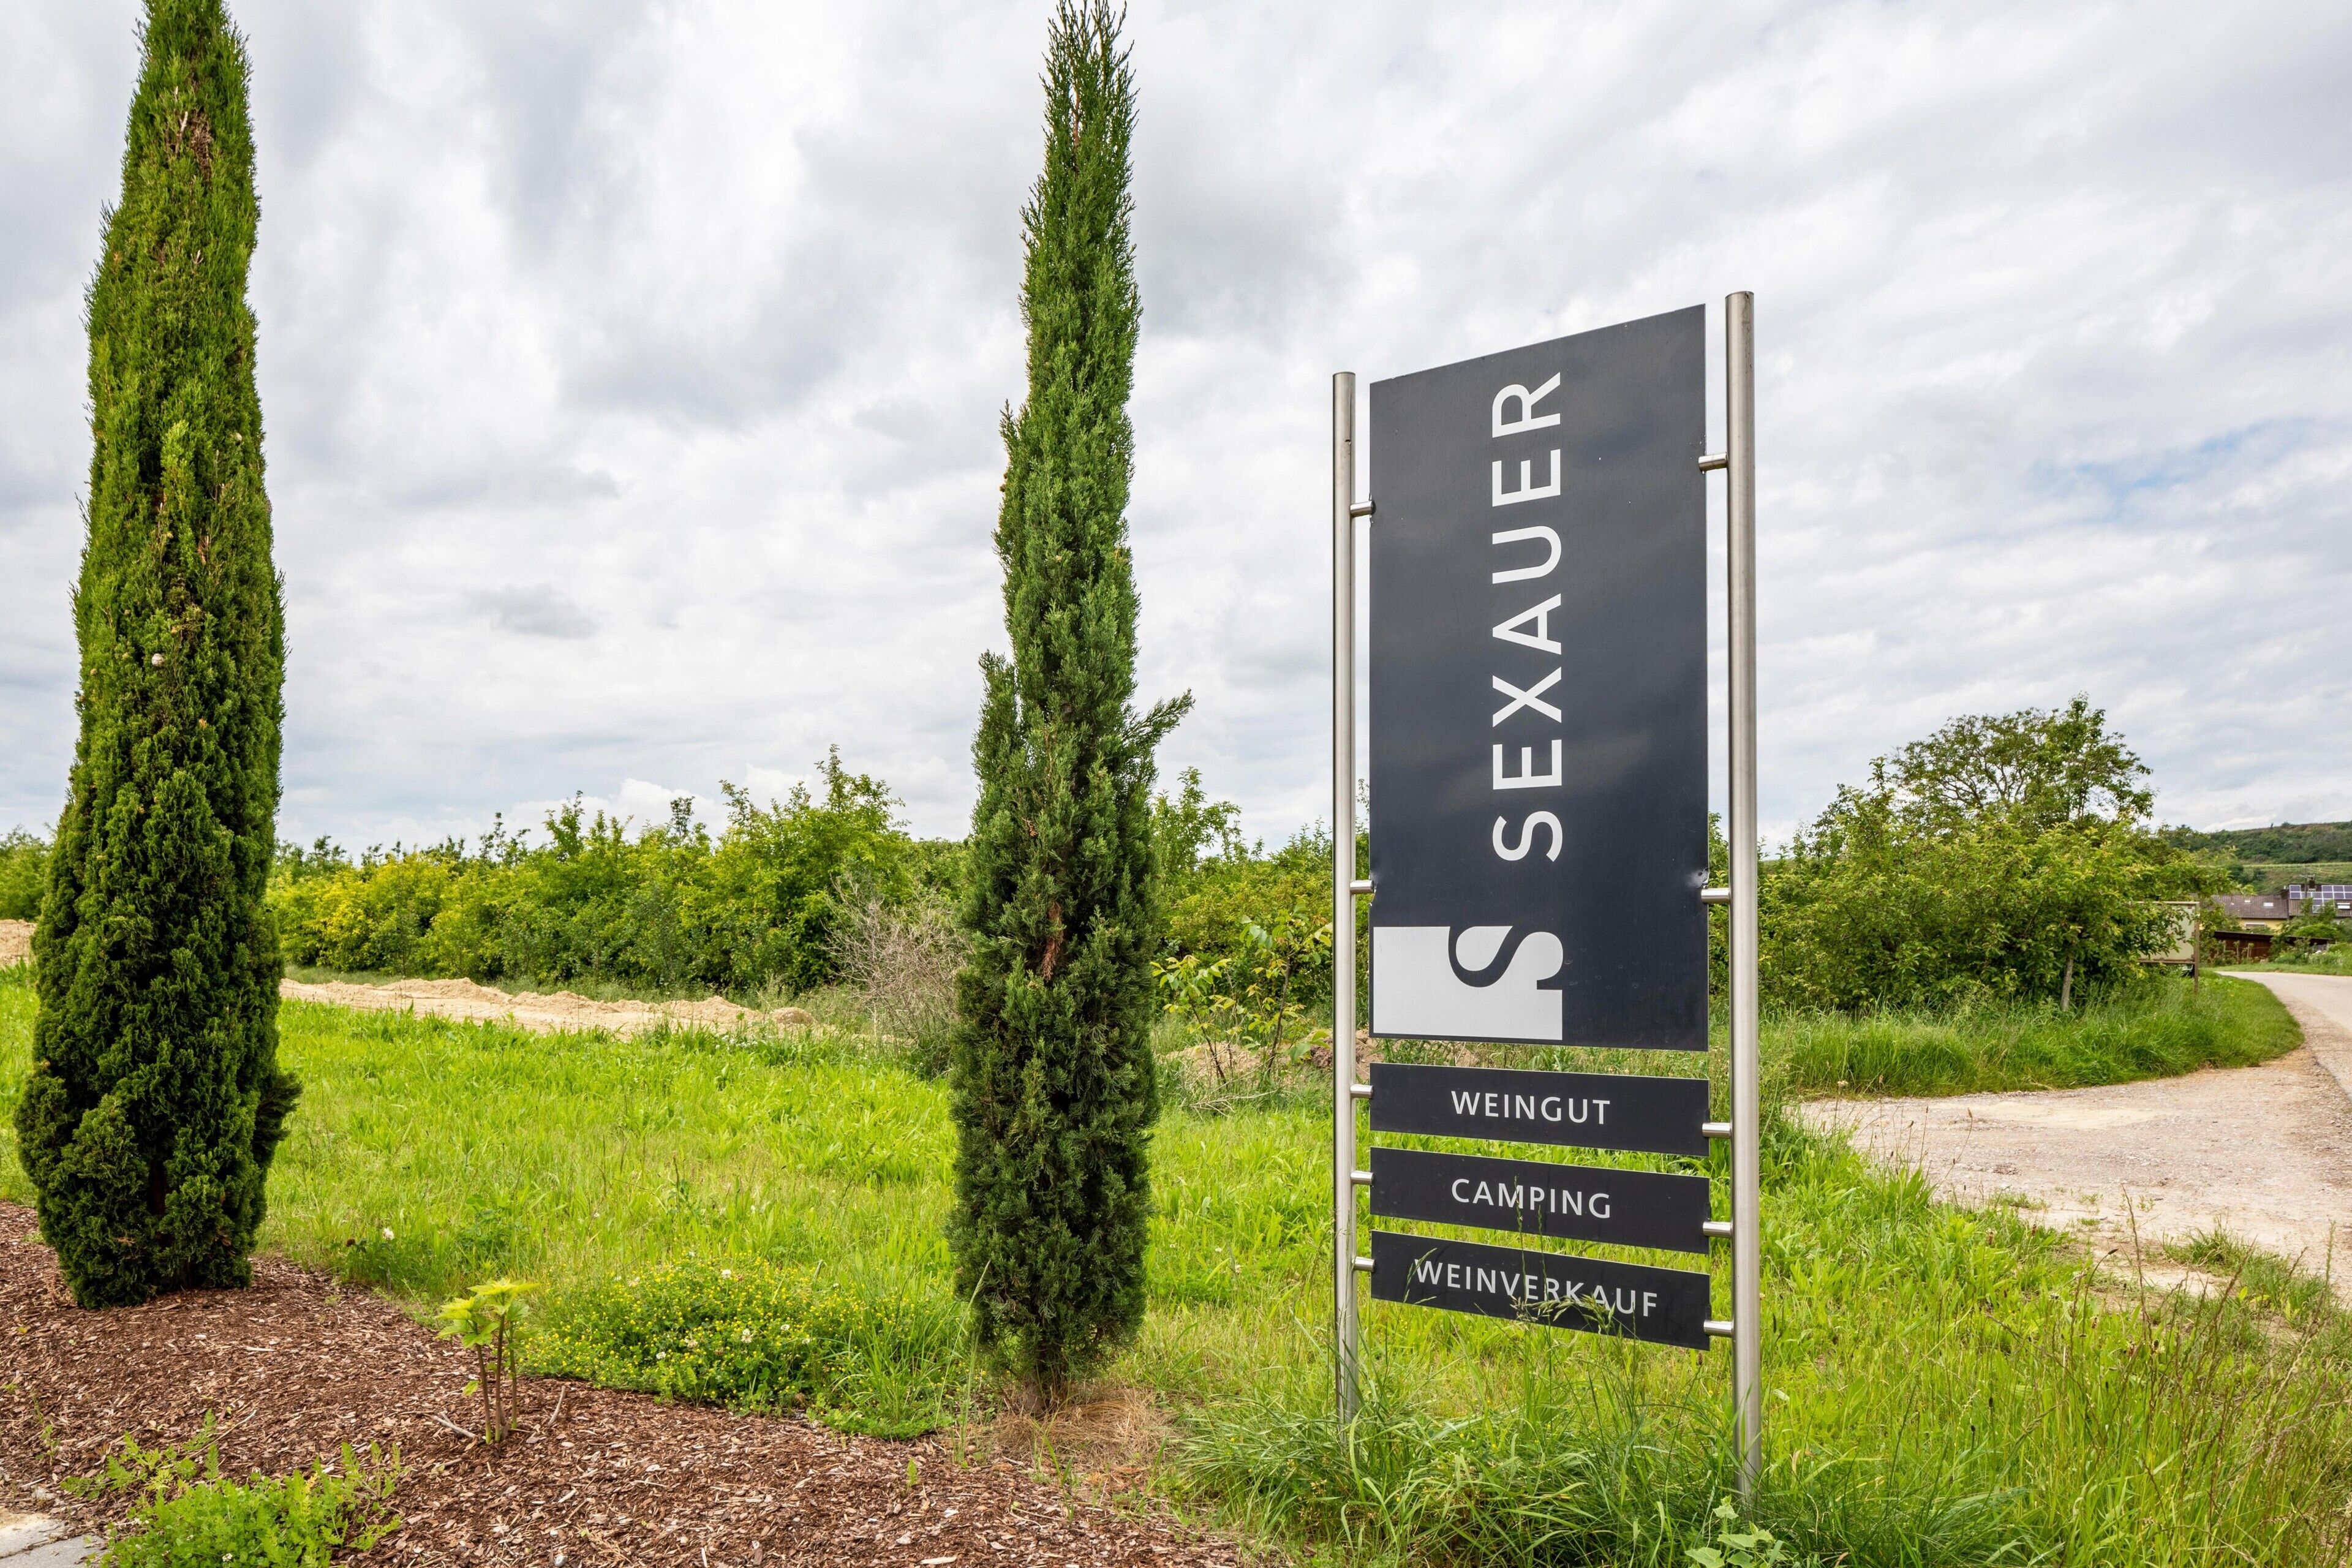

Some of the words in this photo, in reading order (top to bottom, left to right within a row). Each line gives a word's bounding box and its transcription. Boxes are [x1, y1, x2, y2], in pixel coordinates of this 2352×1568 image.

[1491, 371, 1562, 862] SEXAUER
[1450, 1090, 1610, 1125] WEINGUT
[1452, 1178, 1610, 1219] CAMPING
[1414, 1259, 1657, 1317] WEINVERKAUF
